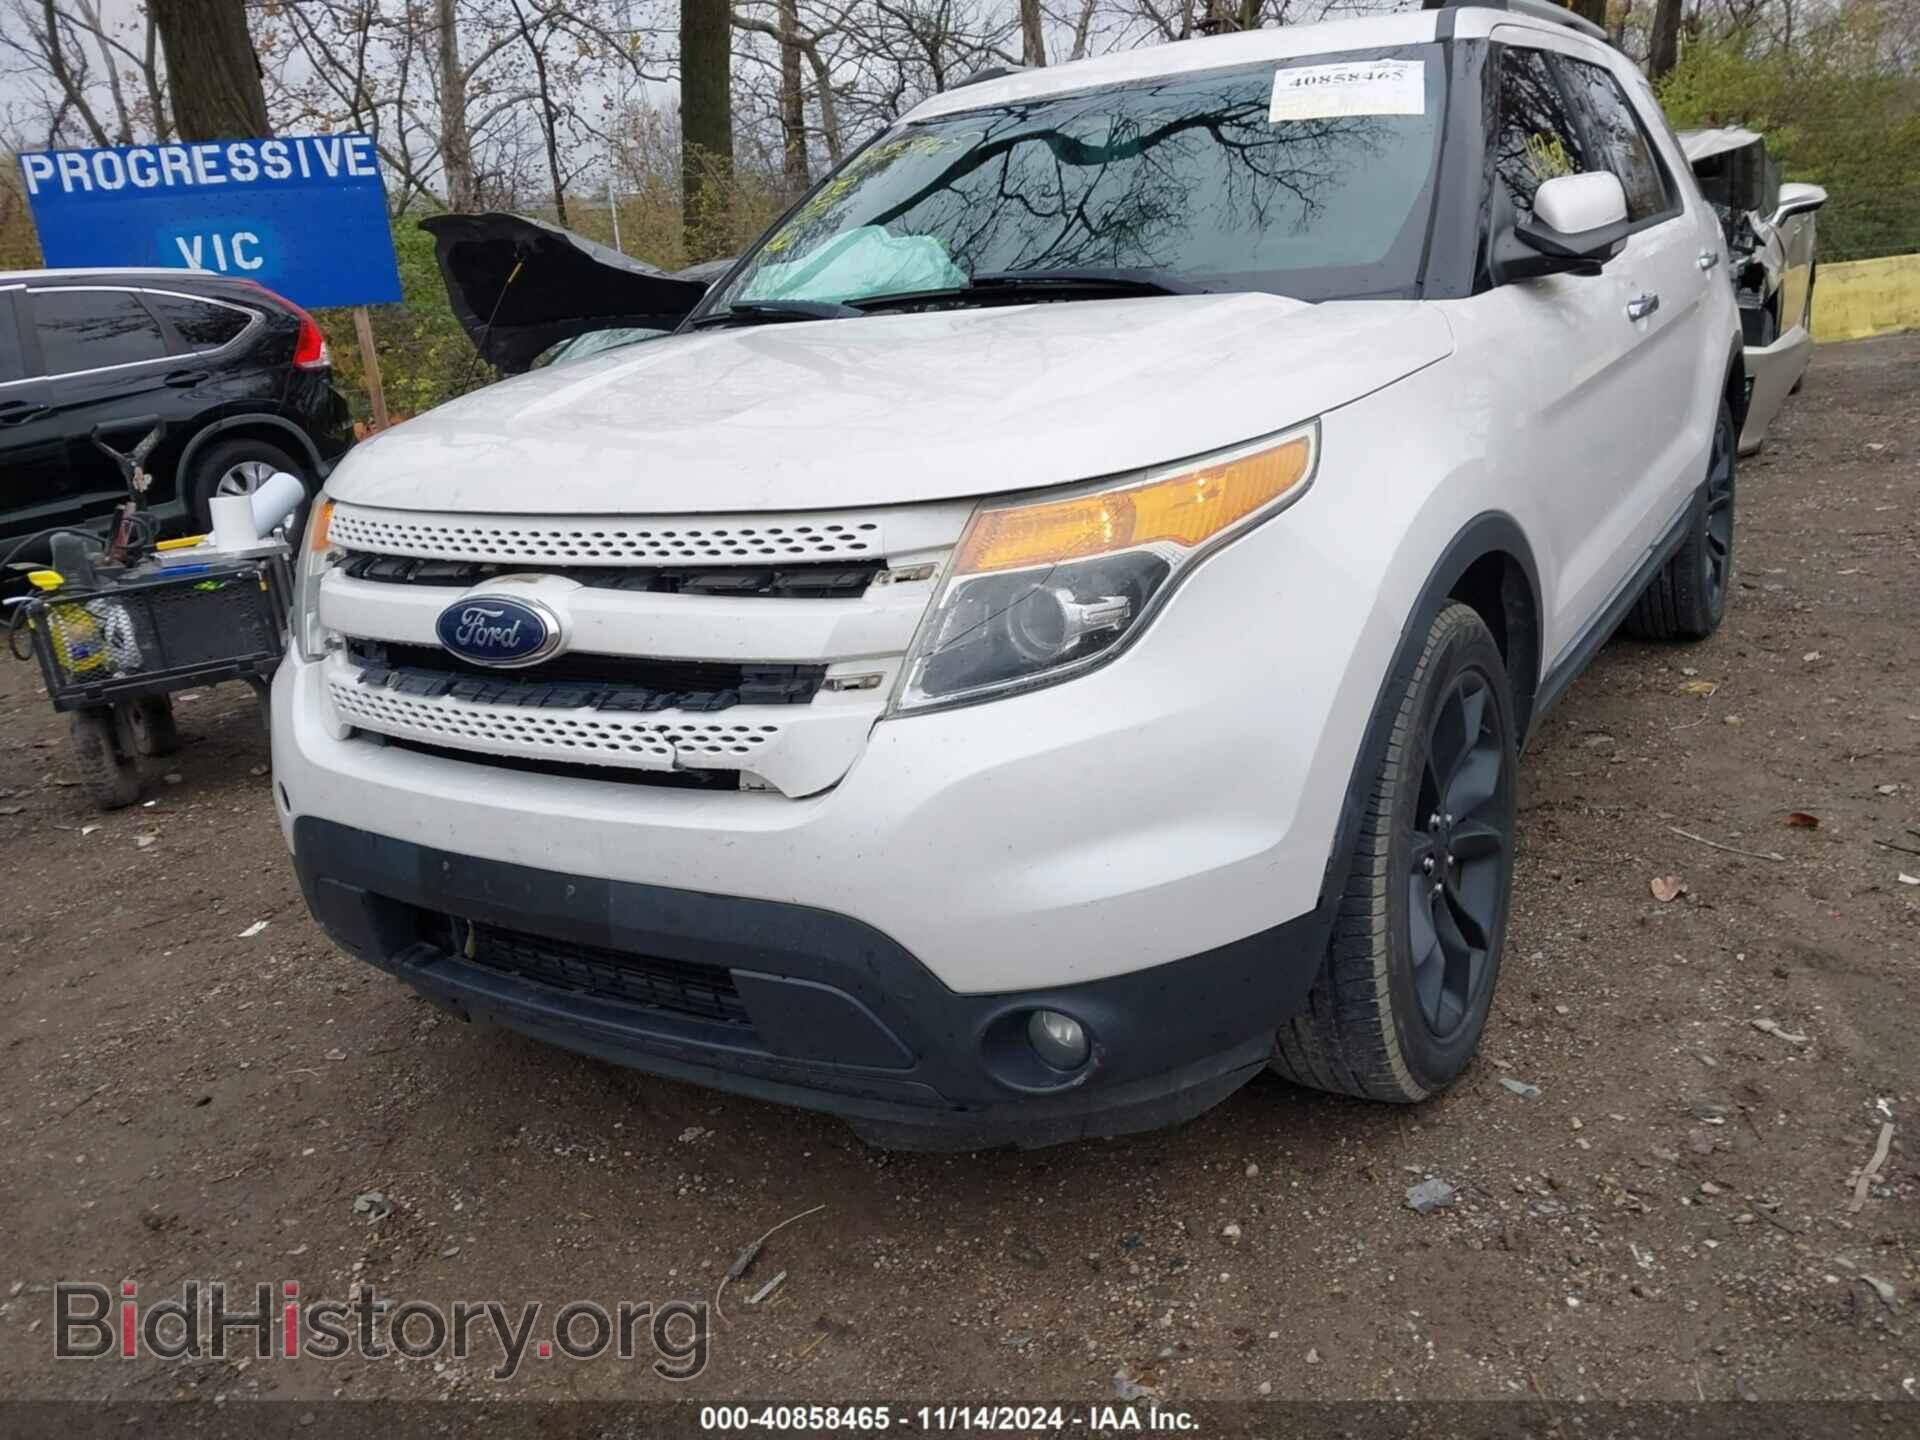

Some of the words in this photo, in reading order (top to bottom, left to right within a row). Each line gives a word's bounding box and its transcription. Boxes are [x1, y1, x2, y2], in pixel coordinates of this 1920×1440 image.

[21, 136, 376, 195] PROGRESSIVE
[175, 231, 264, 272] VIC
[455, 607, 521, 647] Ford
